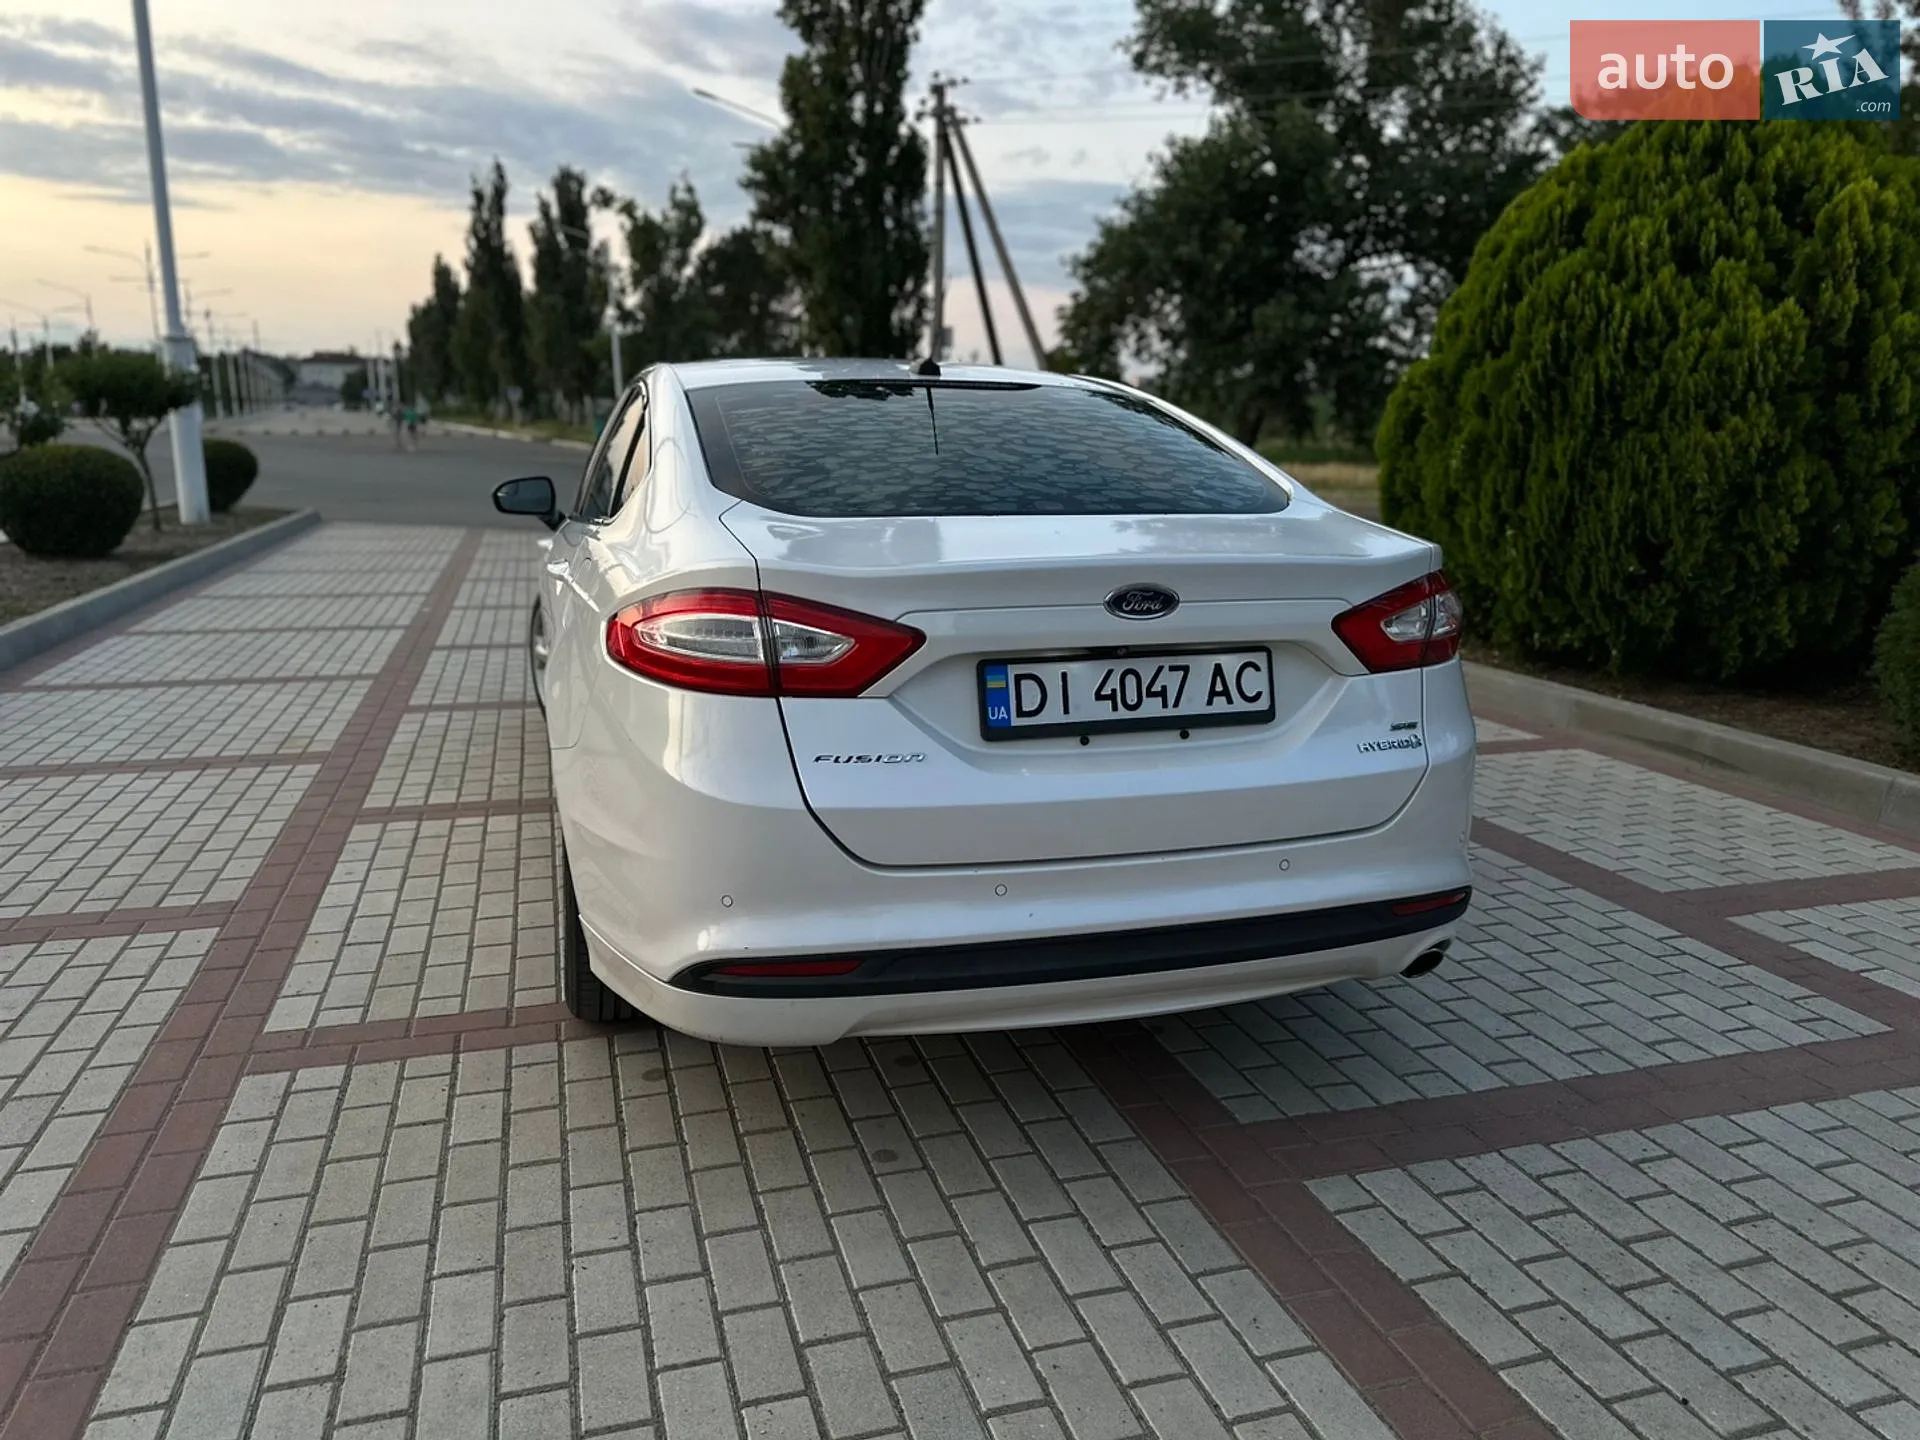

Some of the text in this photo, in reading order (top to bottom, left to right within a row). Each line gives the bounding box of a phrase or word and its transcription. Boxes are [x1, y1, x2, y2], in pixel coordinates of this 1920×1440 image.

[1122, 590, 1165, 611] Ford
[1013, 661, 1263, 718] DI 4047 AC
[988, 706, 1008, 720] UA
[1357, 739, 1412, 754] HYBRID
[813, 754, 926, 764] FUSION
